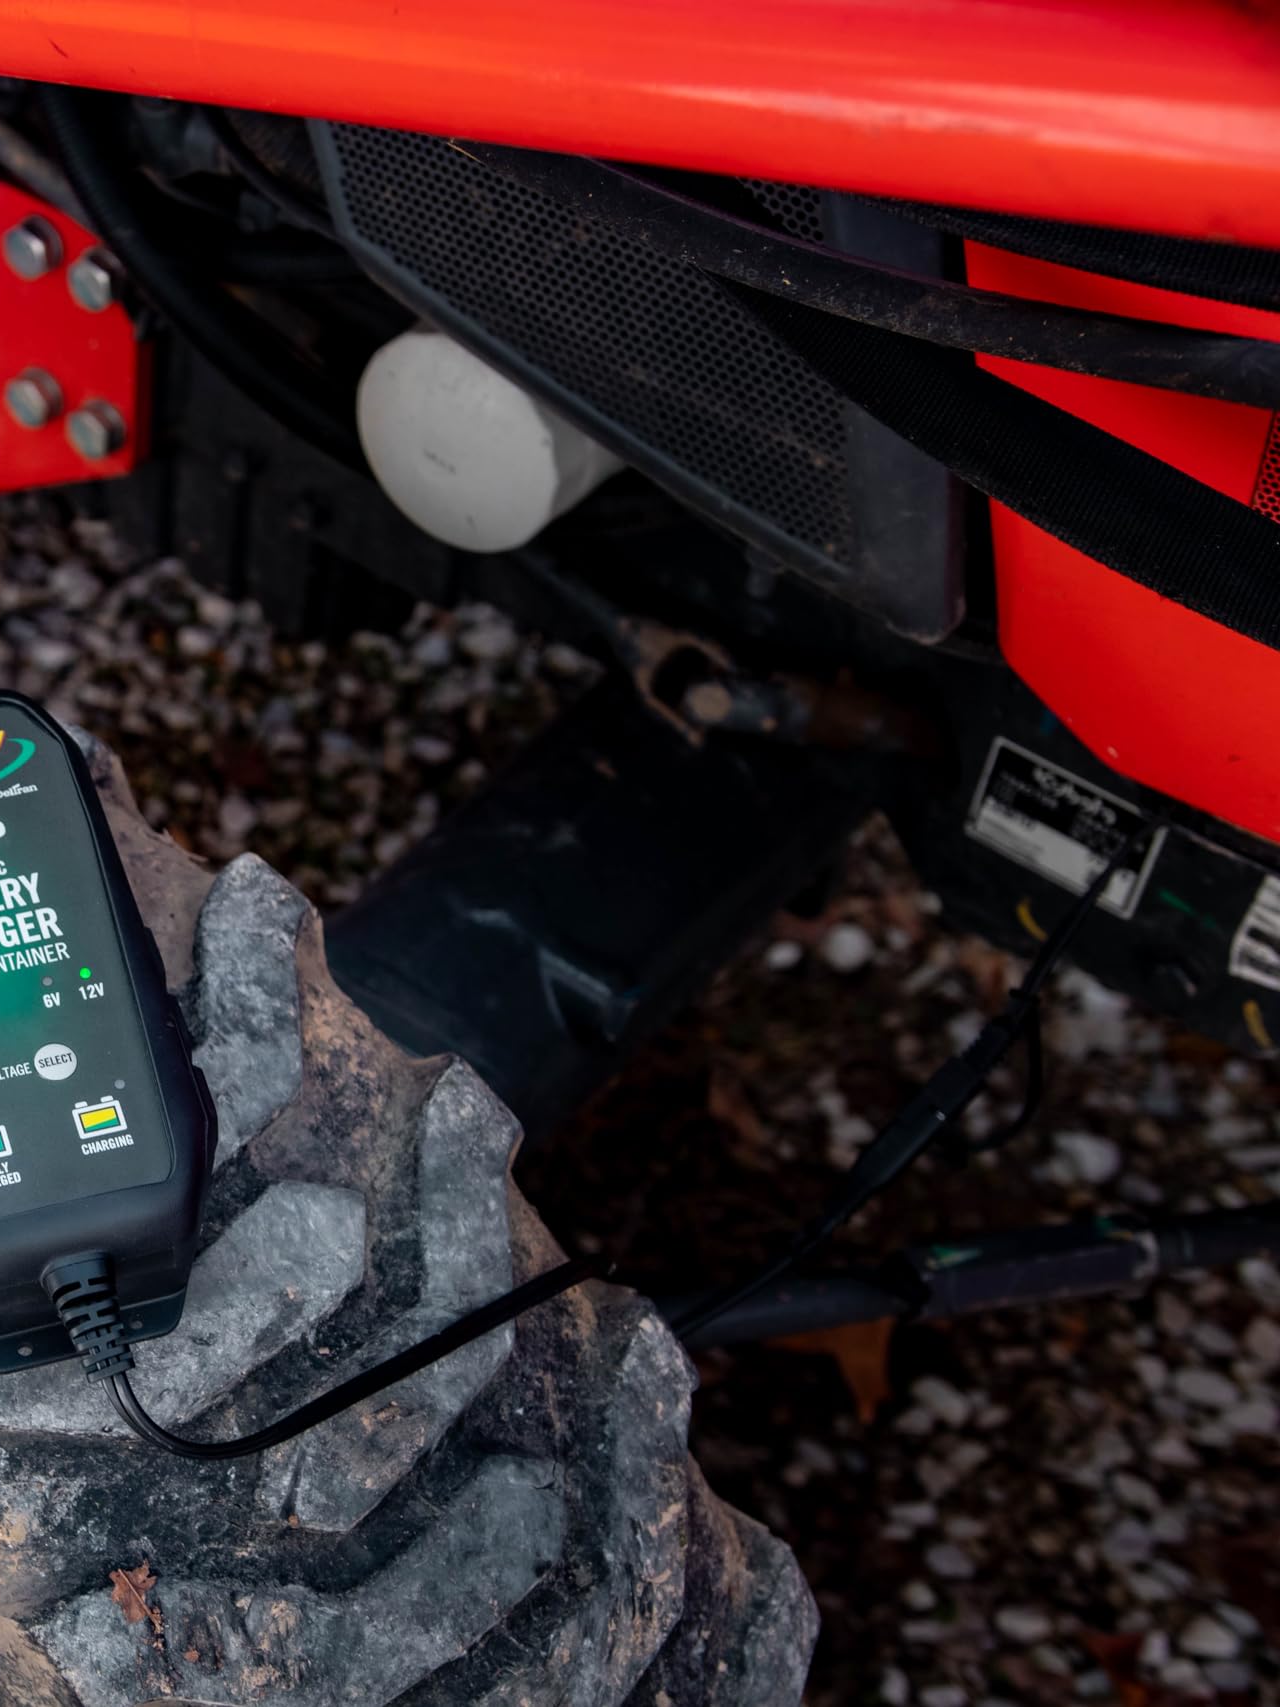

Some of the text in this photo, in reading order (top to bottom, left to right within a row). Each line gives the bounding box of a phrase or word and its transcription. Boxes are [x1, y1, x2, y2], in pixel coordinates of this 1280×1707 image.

[78, 982, 105, 1000] 12V
[42, 992, 61, 1008] 6V
[38, 1052, 74, 1069] SELECT
[81, 1134, 134, 1155] CHARGING
